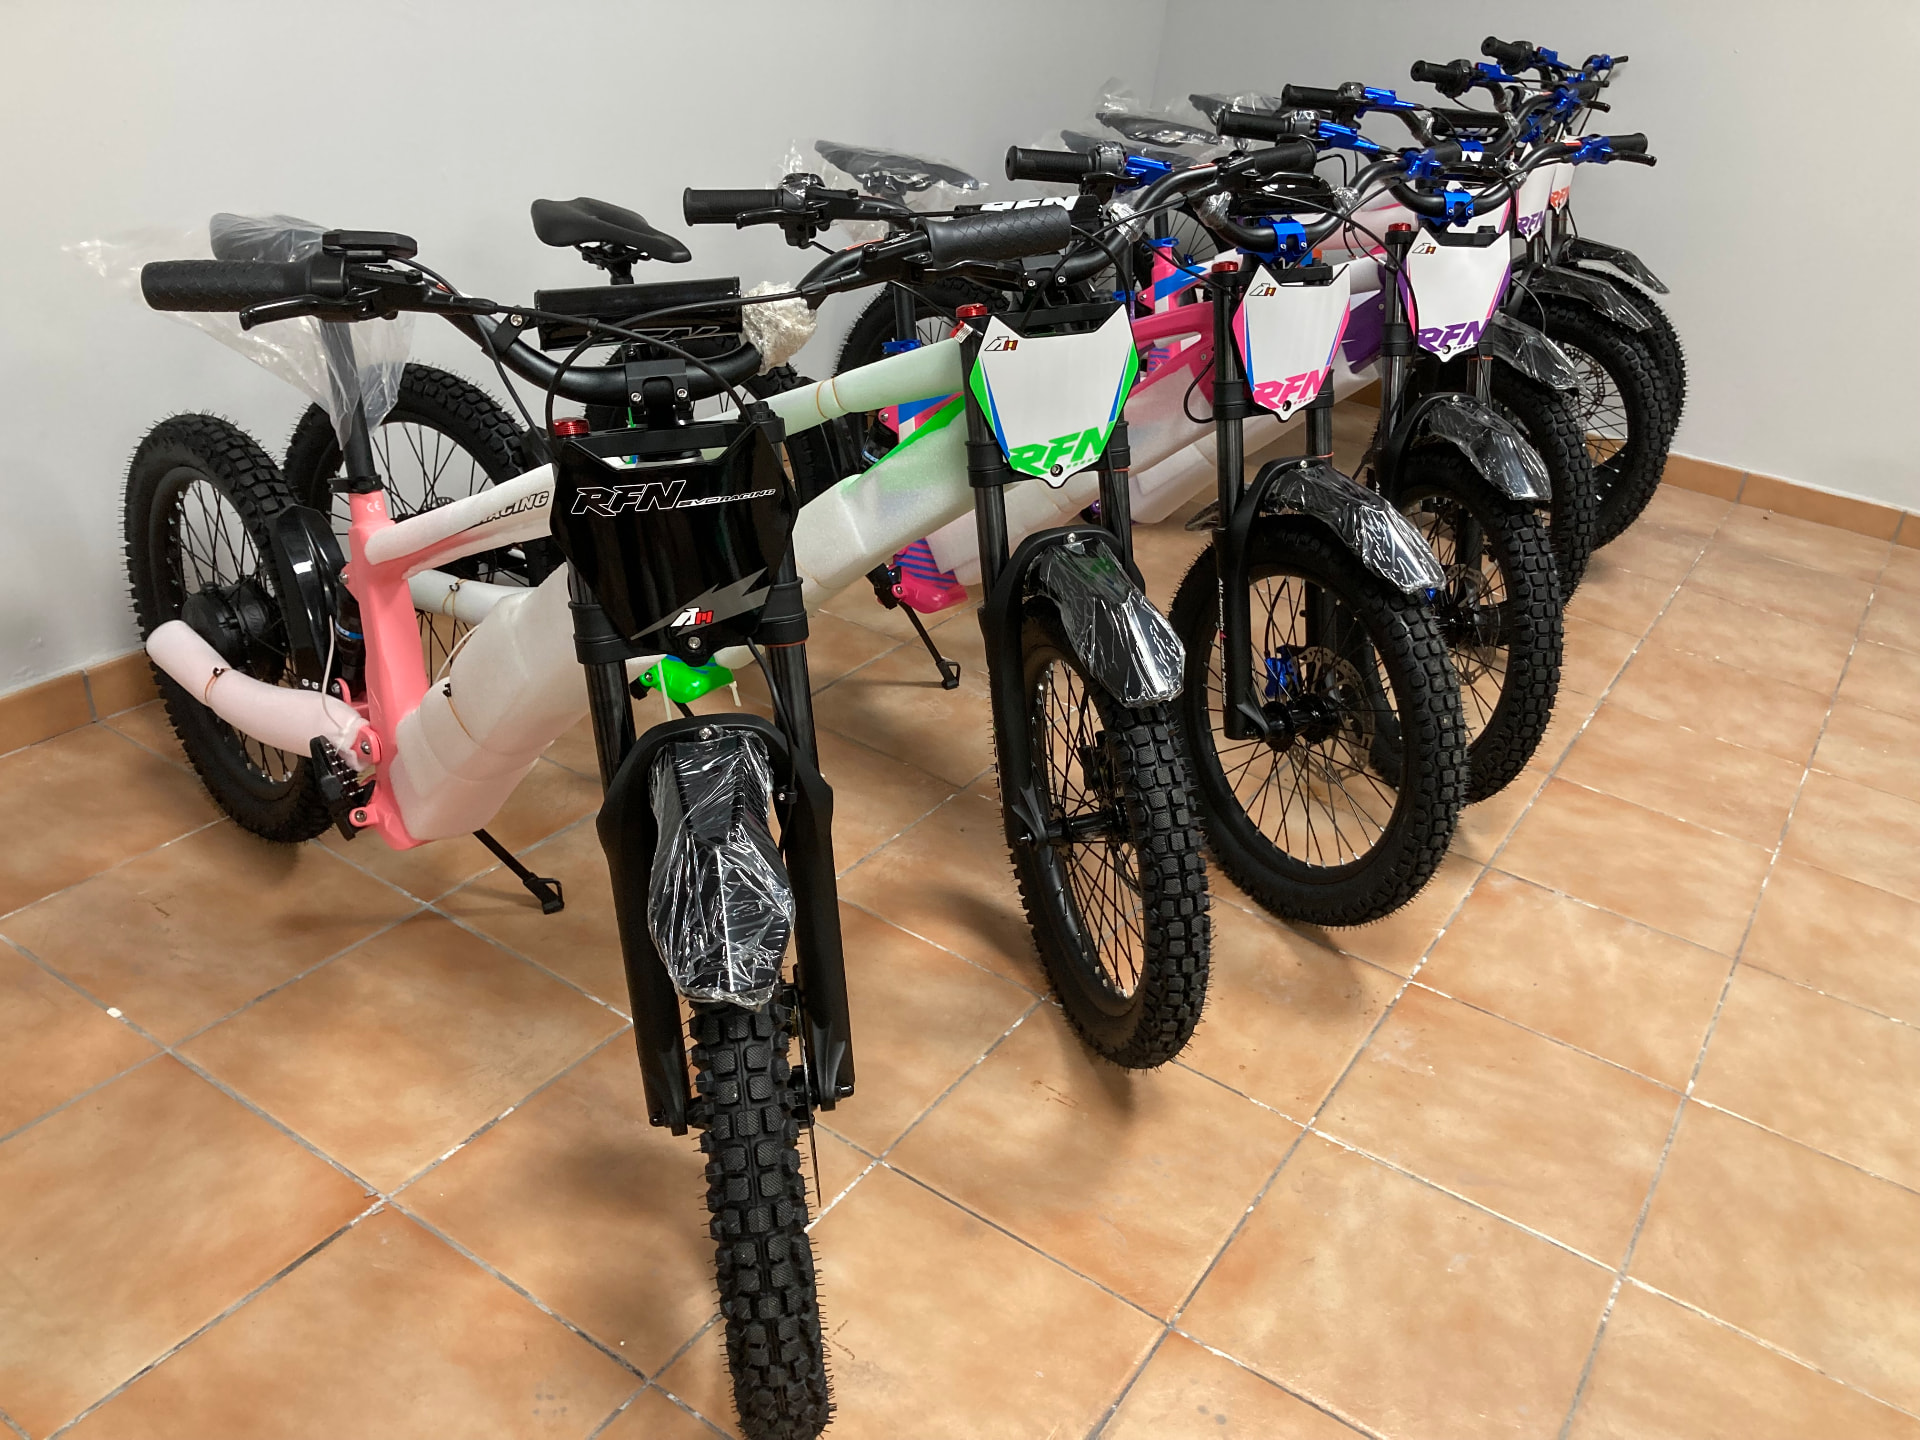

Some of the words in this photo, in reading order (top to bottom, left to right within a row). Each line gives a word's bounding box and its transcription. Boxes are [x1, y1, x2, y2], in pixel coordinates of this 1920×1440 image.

[1418, 320, 1487, 353] RFN
[1253, 369, 1328, 410] RFN
[1008, 426, 1112, 477] RFN
[366, 500, 382, 513] CE
[571, 480, 687, 517] RFN
